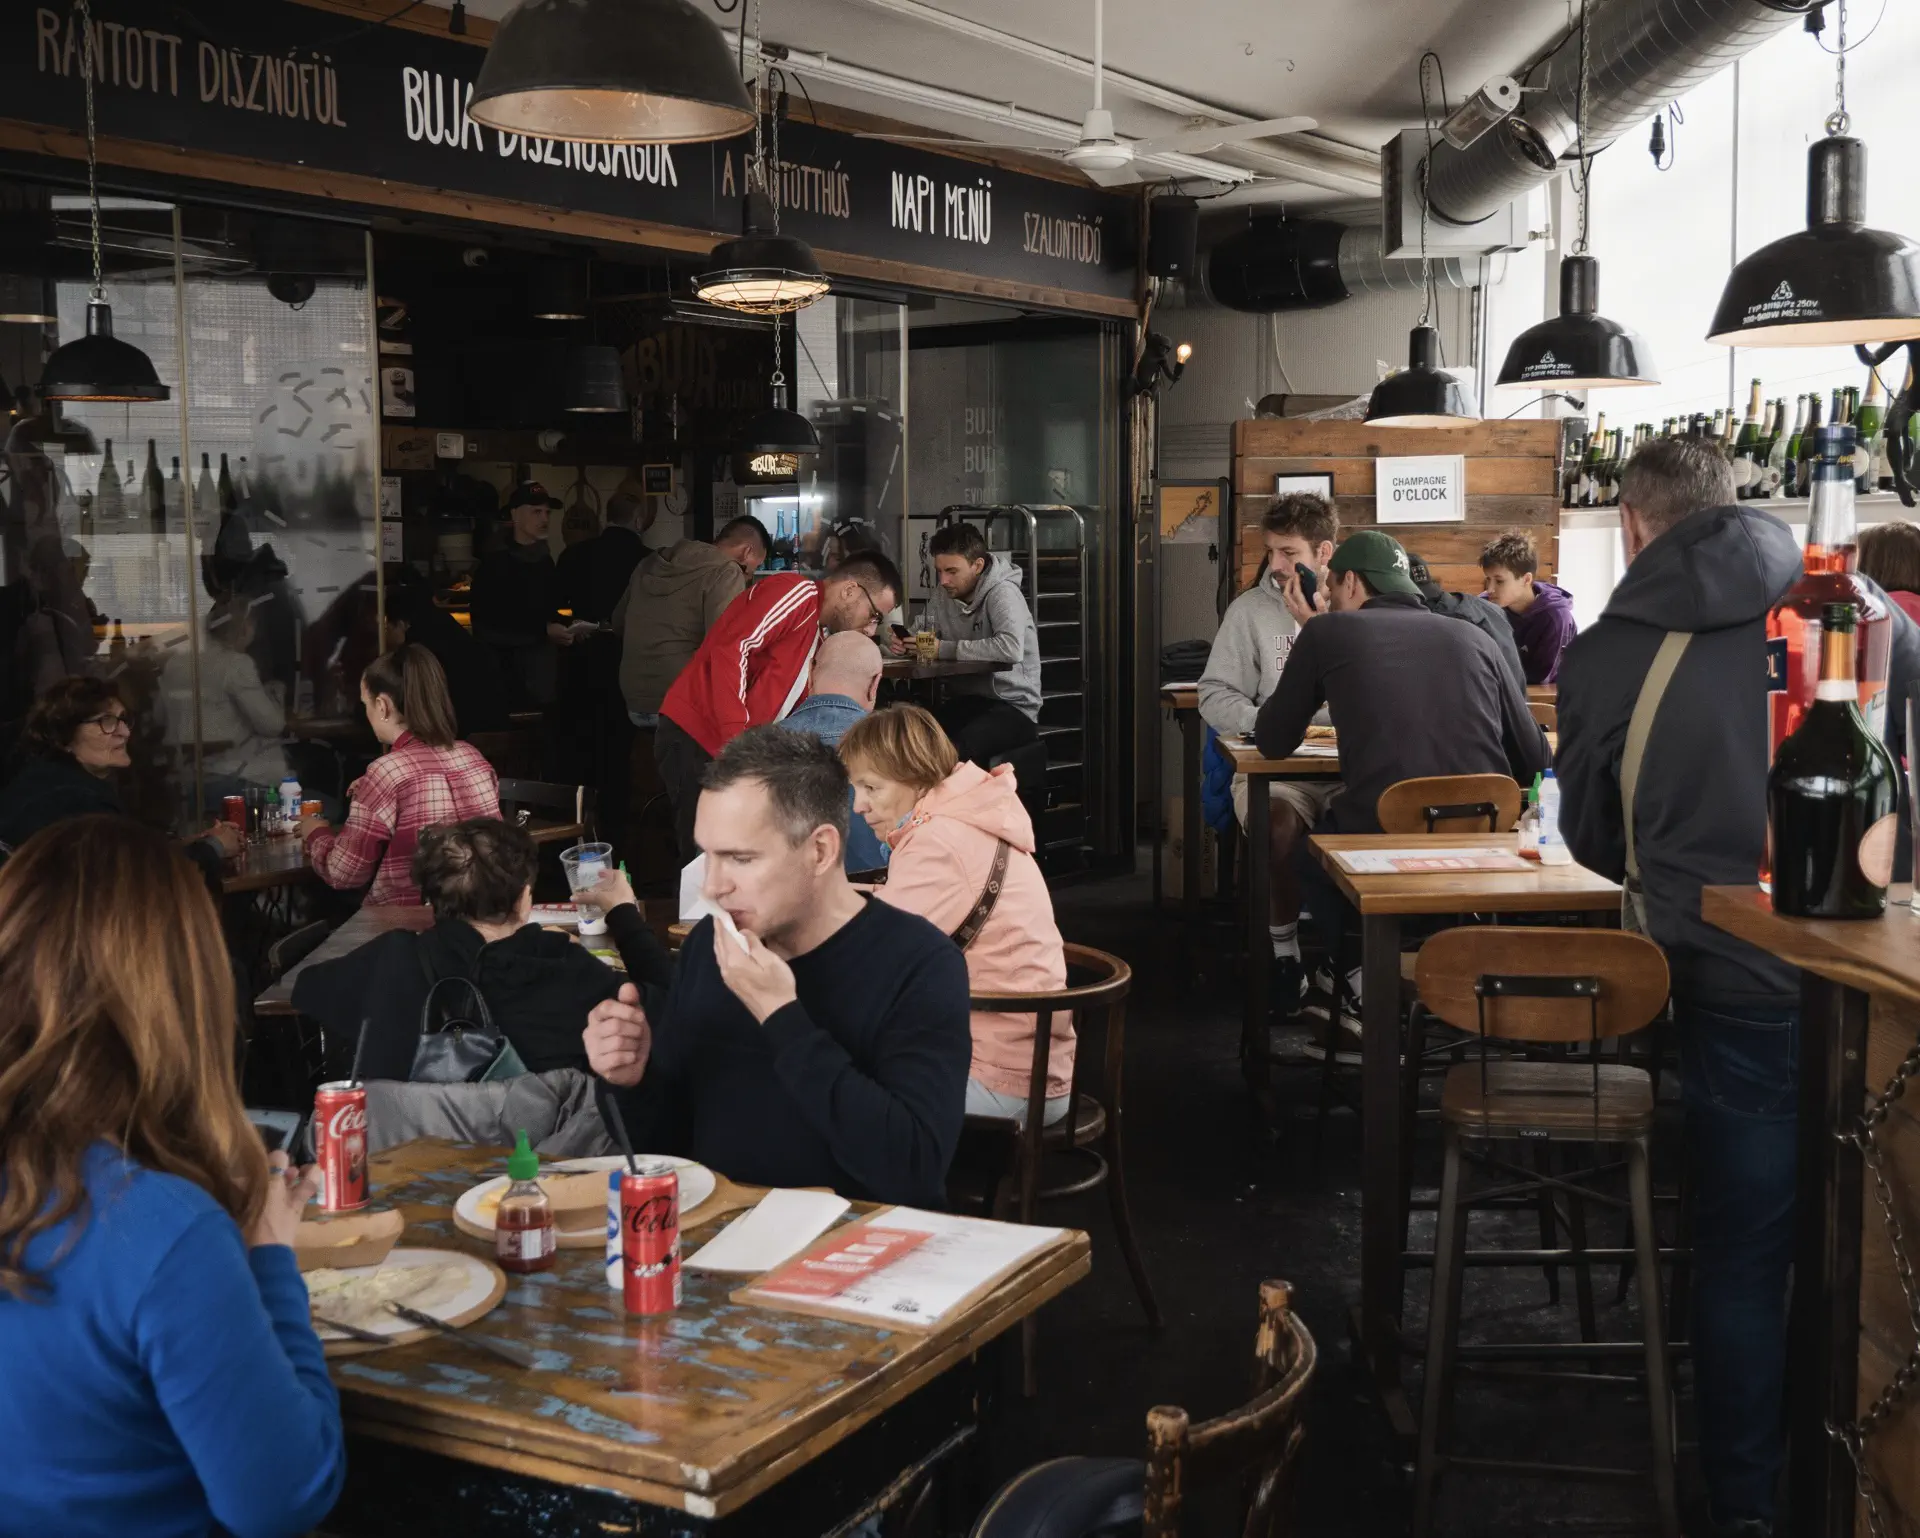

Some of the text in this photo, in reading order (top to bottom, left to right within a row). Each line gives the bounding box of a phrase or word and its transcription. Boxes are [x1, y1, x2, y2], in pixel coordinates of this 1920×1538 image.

[200, 46, 347, 127] DISZNÓFÜL
[403, 66, 483, 152] BUJA
[891, 170, 992, 245] NAPI MENÜ
[1022, 211, 1103, 265] SZALONTÜDŐ
[1796, 300, 1818, 309] 250V
[1781, 308, 1800, 318] MSZ
[1392, 475, 1447, 487] CHAMPAGNE
[1393, 488, 1447, 502] O'CLOCK
[1276, 656, 1288, 671] O
